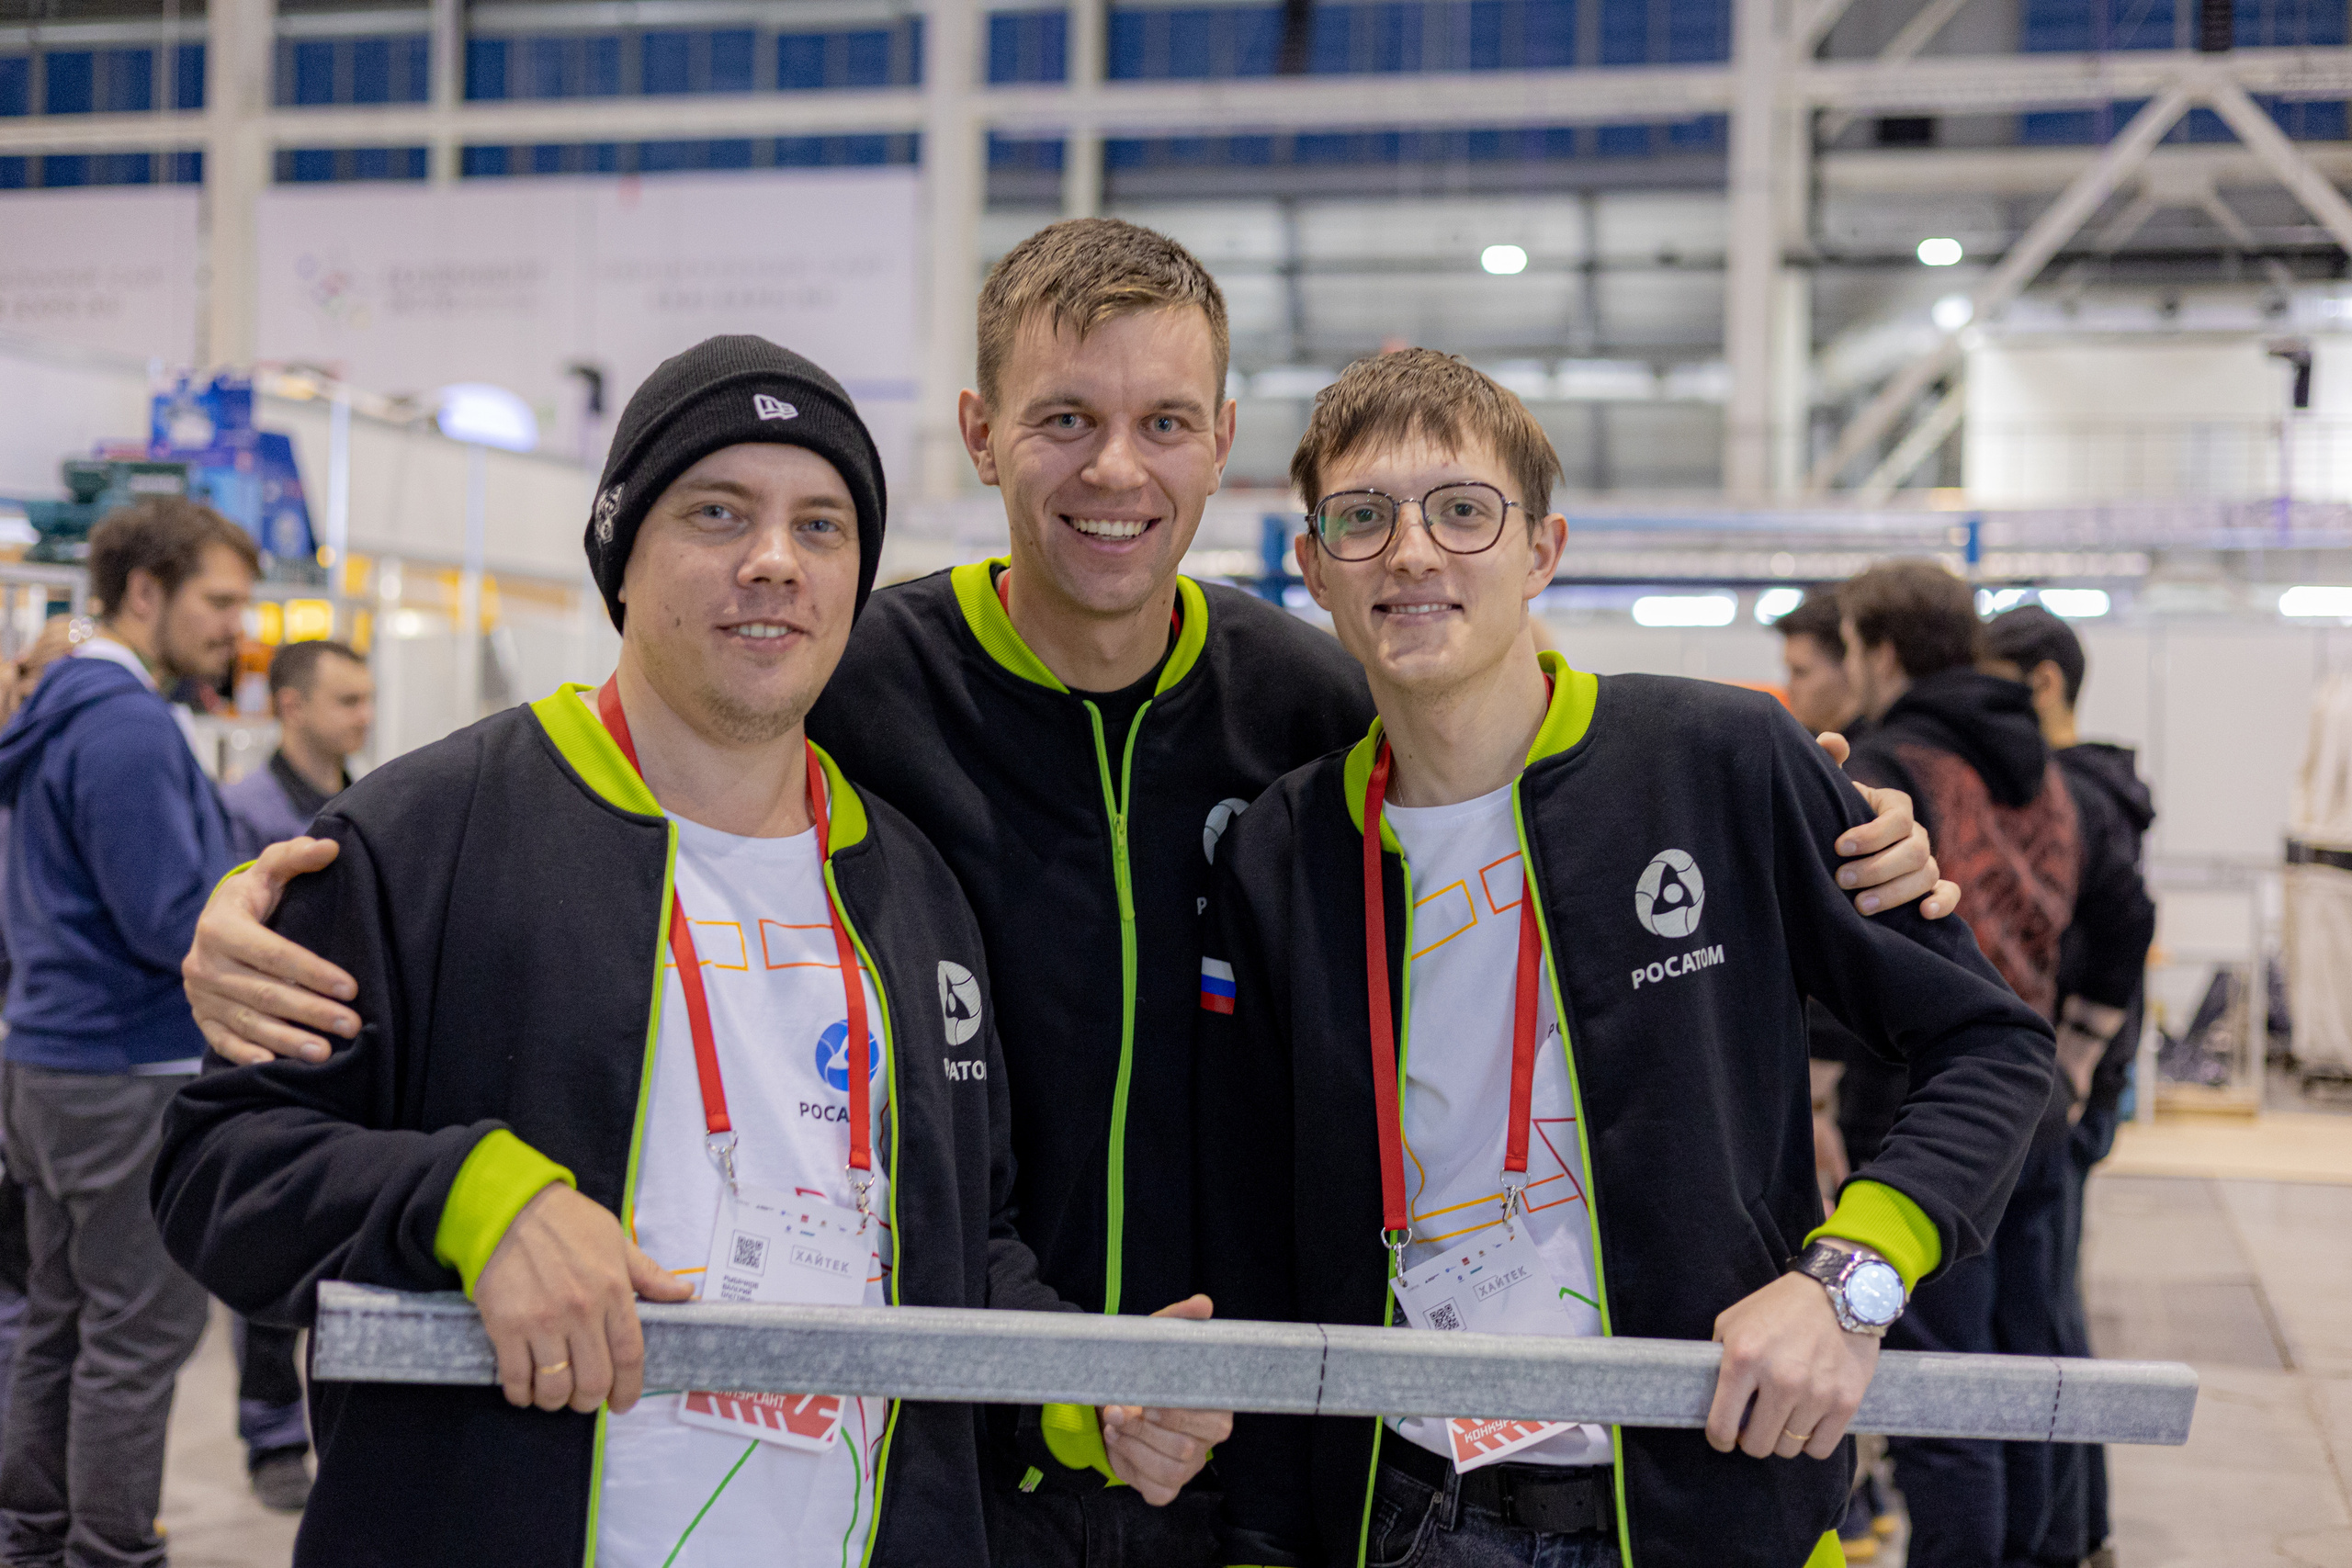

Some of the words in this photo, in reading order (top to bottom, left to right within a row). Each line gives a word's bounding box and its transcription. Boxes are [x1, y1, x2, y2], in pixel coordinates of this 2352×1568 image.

[1632, 944, 1724, 989] РОСАТОМ
[944, 1057, 987, 1081] АТО
[799, 1101, 850, 1122] РОСА
[796, 1250, 849, 1273] ХАЙТЕК
[1479, 1266, 1527, 1296] ХАЙТЕК
[1464, 1419, 1518, 1444] КОНКУР
